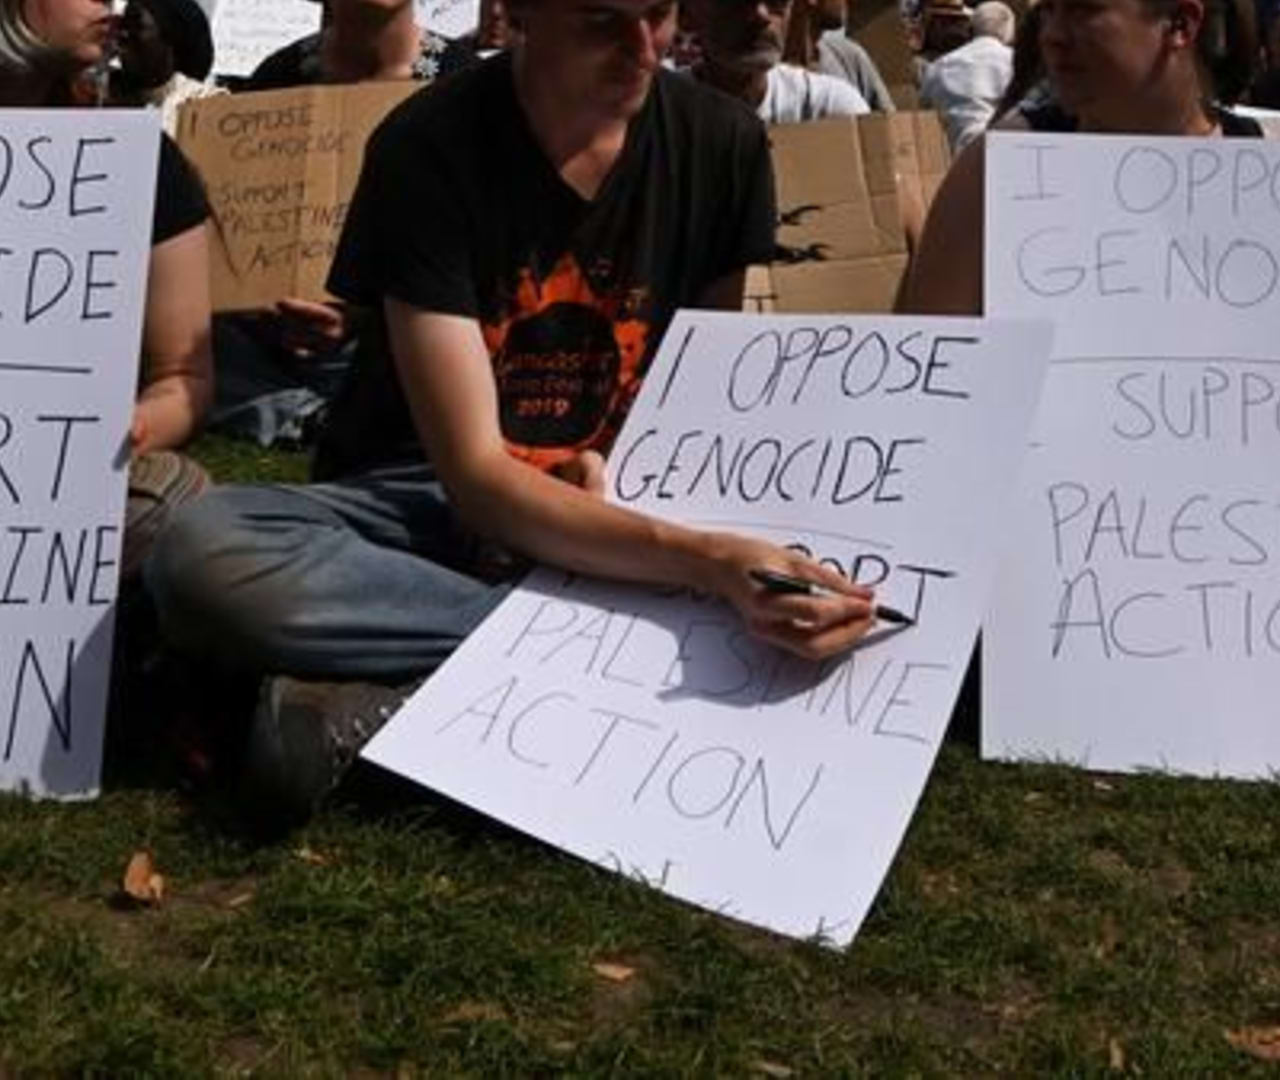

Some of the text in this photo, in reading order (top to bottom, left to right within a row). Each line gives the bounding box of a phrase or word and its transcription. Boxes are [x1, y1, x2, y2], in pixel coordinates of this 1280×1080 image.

[1012, 144, 1064, 201] I
[657, 325, 983, 416] I OPPOSE
[614, 428, 926, 506] GENOCIDE
[434, 675, 825, 851] ACTION
